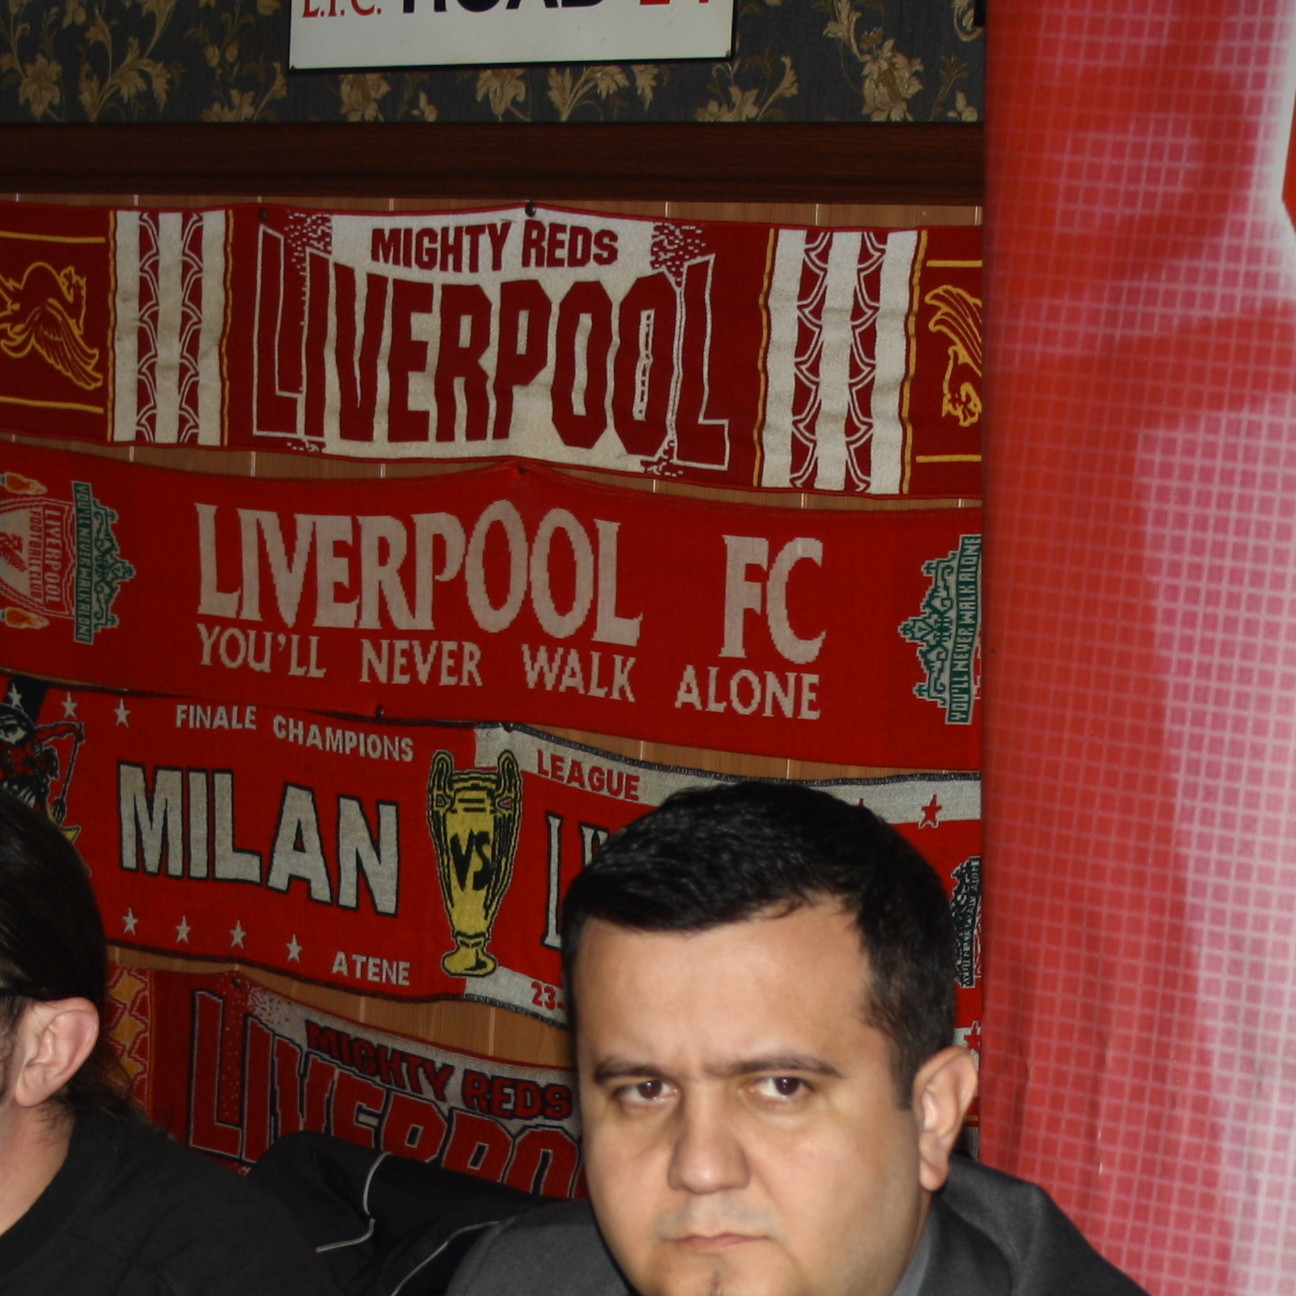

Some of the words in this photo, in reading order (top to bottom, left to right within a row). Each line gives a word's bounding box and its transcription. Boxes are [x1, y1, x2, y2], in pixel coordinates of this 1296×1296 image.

[371, 220, 512, 273] MIGHTY
[521, 219, 619, 268] REDS
[252, 222, 730, 471] LIVERPOOL
[29, 510, 43, 568] FOOTBALL
[44, 508, 62, 605] LIVERPOOL
[959, 537, 982, 582] ALONE
[30, 571, 43, 599] CLUB
[194, 499, 644, 647] LIVERPOOL
[719, 534, 826, 664] FC
[958, 585, 977, 624] WALK
[197, 623, 326, 679] YOU'LL
[359, 637, 483, 686] NEVER
[521, 643, 637, 702] WALK
[674, 663, 821, 721] ALONE
[953, 627, 973, 672] NEVER
[950, 675, 969, 721] YOU'LL
[175, 703, 258, 732] FINALE
[272, 714, 415, 763] CHAMPIONS
[536, 748, 641, 802] LEAGUE
[117, 763, 400, 917] MILAN
[449, 828, 493, 893] VS
[331, 951, 412, 987] ATENE
[305, 1019, 455, 1102] MIGHTY
[462, 1070, 574, 1120] REDS
